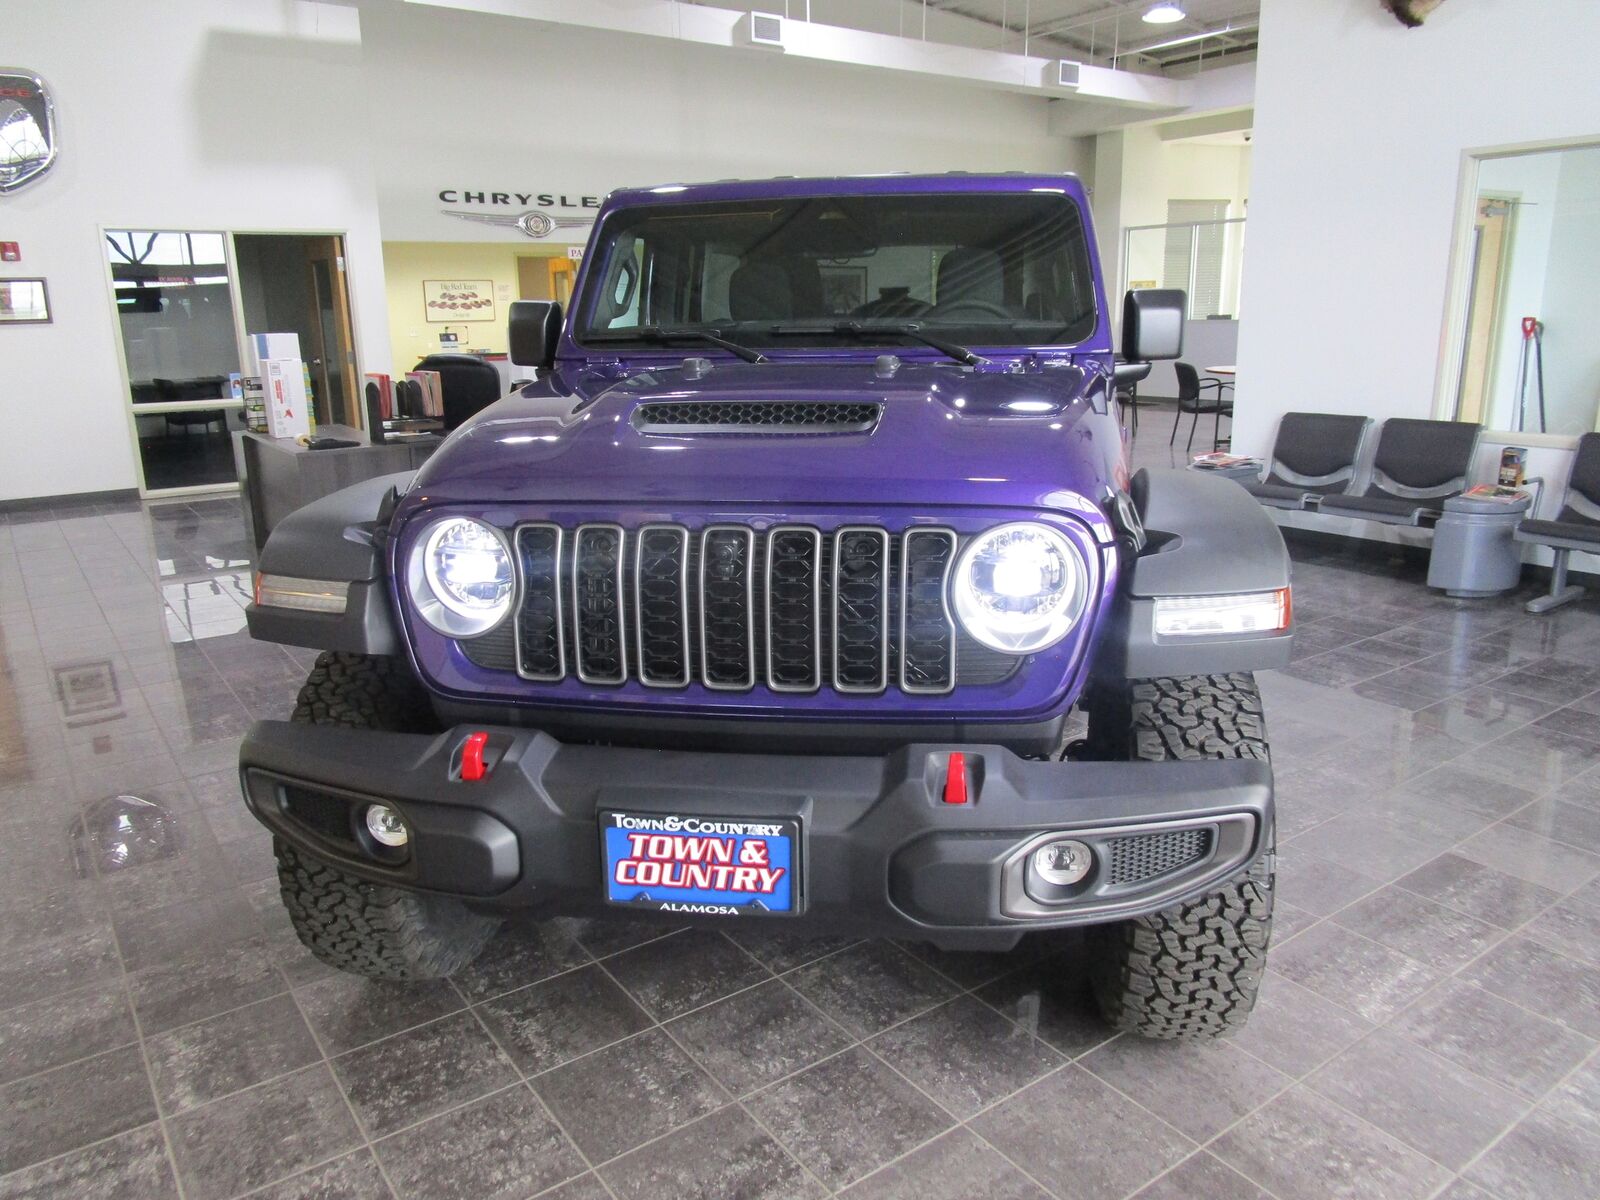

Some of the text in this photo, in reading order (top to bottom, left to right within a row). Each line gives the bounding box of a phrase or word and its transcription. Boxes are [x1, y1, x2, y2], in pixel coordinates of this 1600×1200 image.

[438, 190, 601, 209] CHRYSLE
[628, 833, 769, 865] TOWN &
[614, 859, 785, 893] COUNTRY
[659, 902, 739, 915] ALAMOSA
